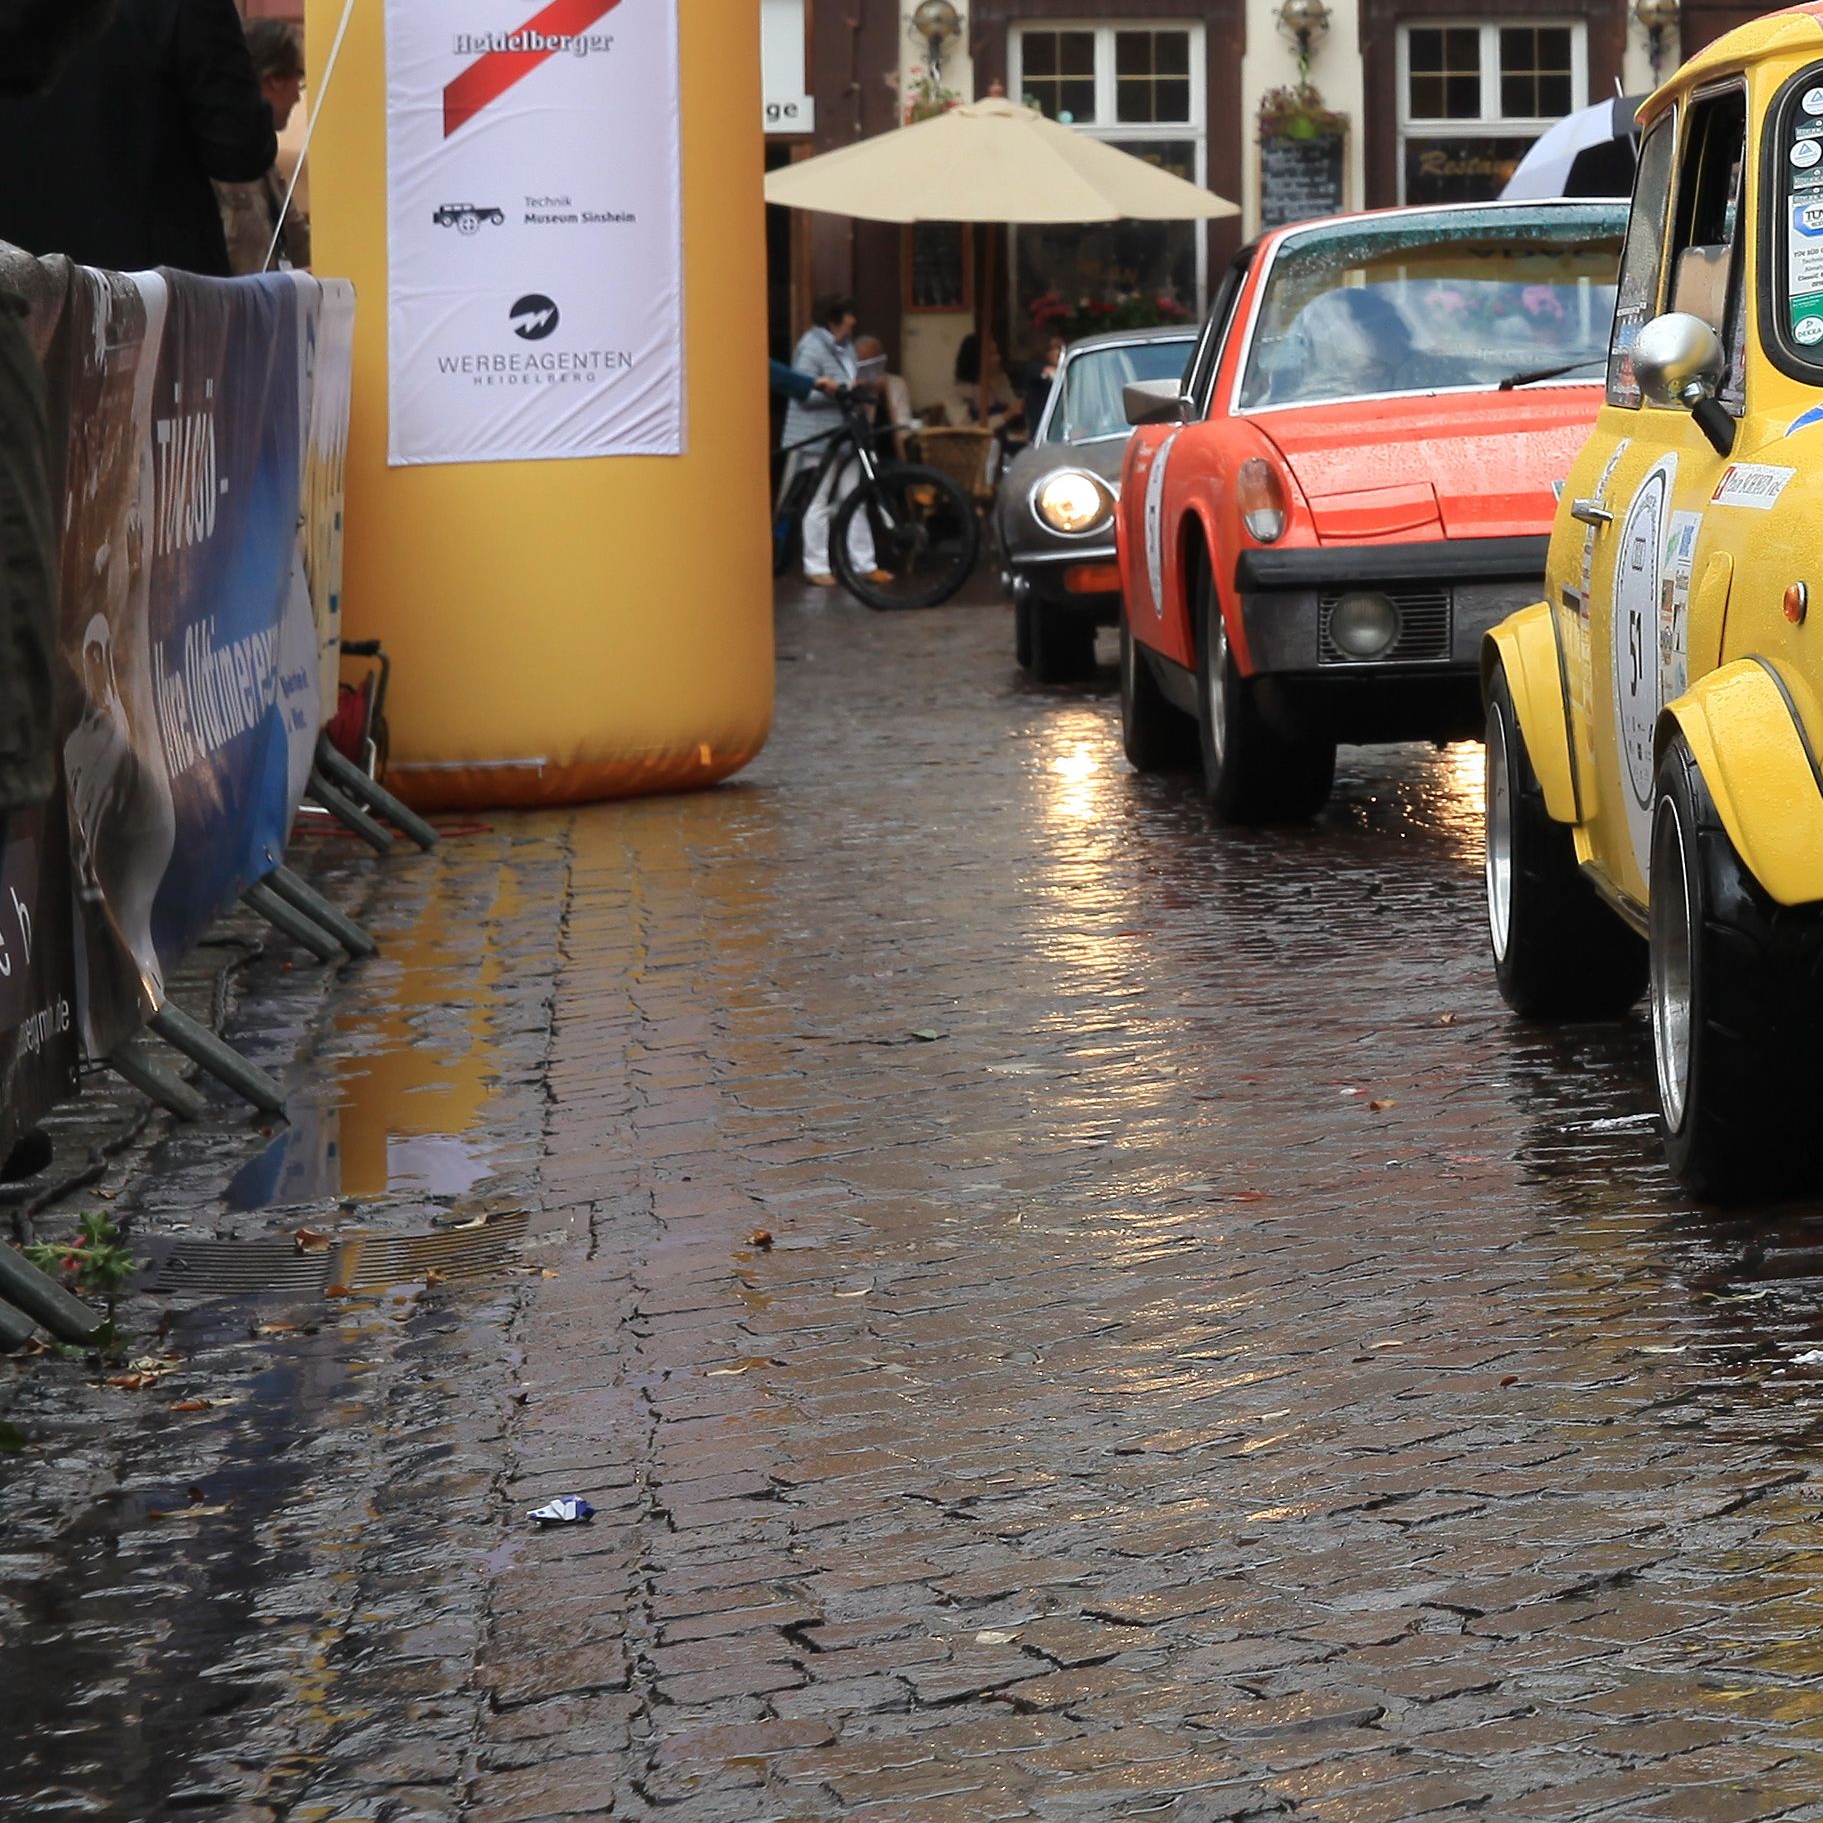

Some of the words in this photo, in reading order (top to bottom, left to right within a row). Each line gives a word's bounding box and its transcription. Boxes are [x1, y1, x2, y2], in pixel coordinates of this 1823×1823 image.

[452, 29, 614, 58] Heidelberger
[524, 195, 573, 209] Technik
[524, 211, 579, 225] Museum
[581, 210, 637, 225] Sinsheim
[437, 350, 634, 374] WERBEAGENTEN
